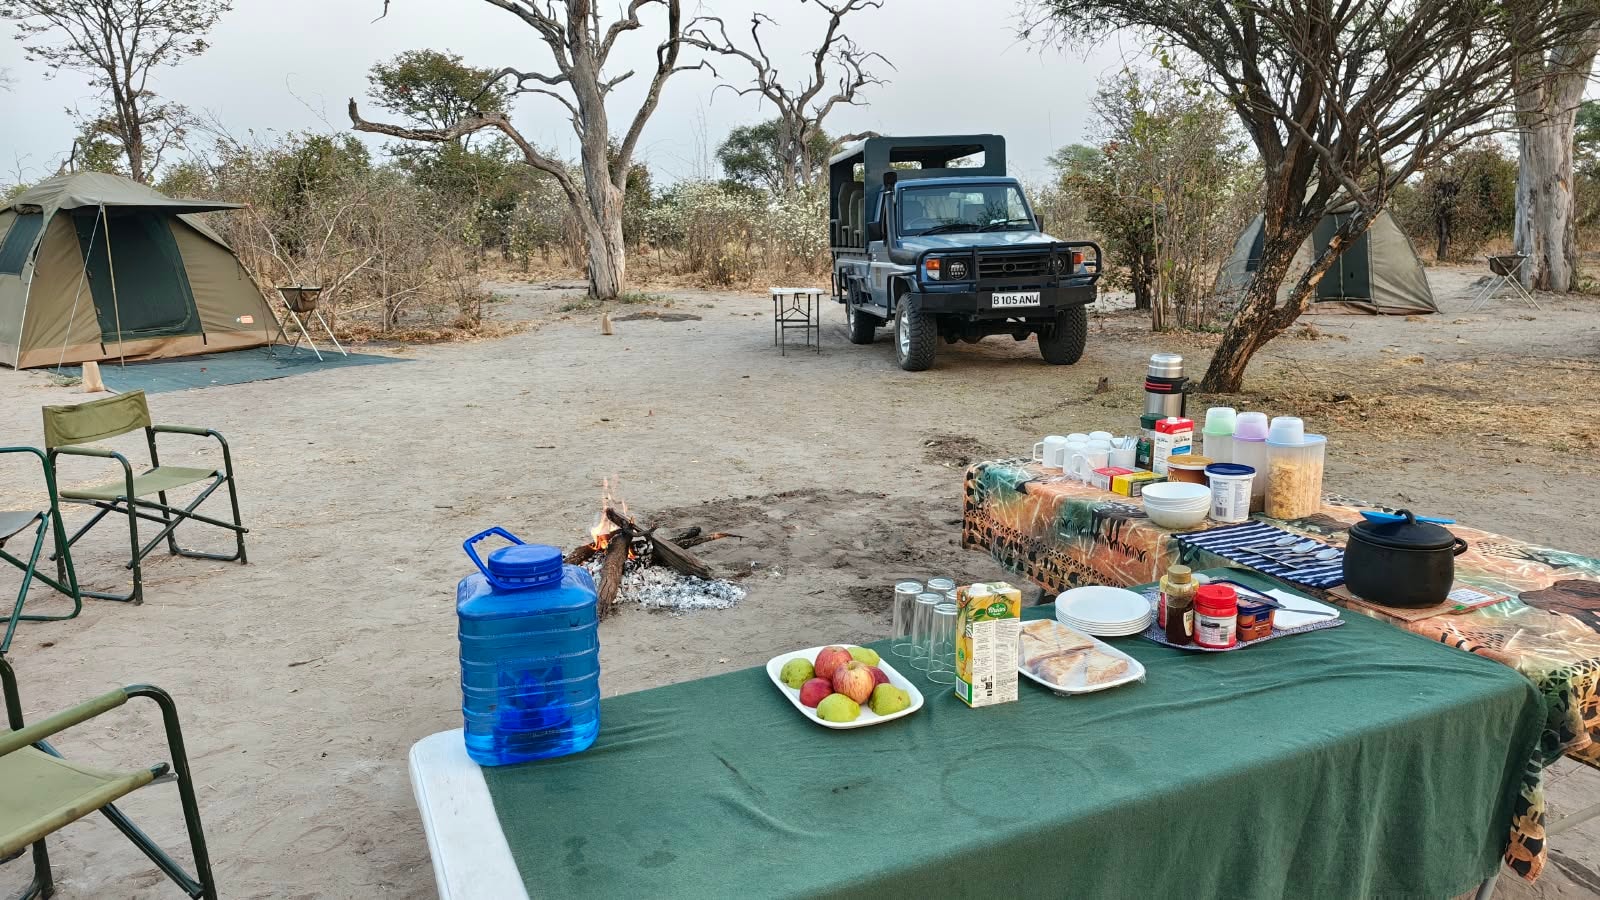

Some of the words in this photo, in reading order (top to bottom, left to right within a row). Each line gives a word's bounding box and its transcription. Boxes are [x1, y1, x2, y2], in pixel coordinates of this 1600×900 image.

[993, 296, 999, 304] B
[1001, 295, 1018, 304] 105
[1019, 294, 1039, 304] ANW
